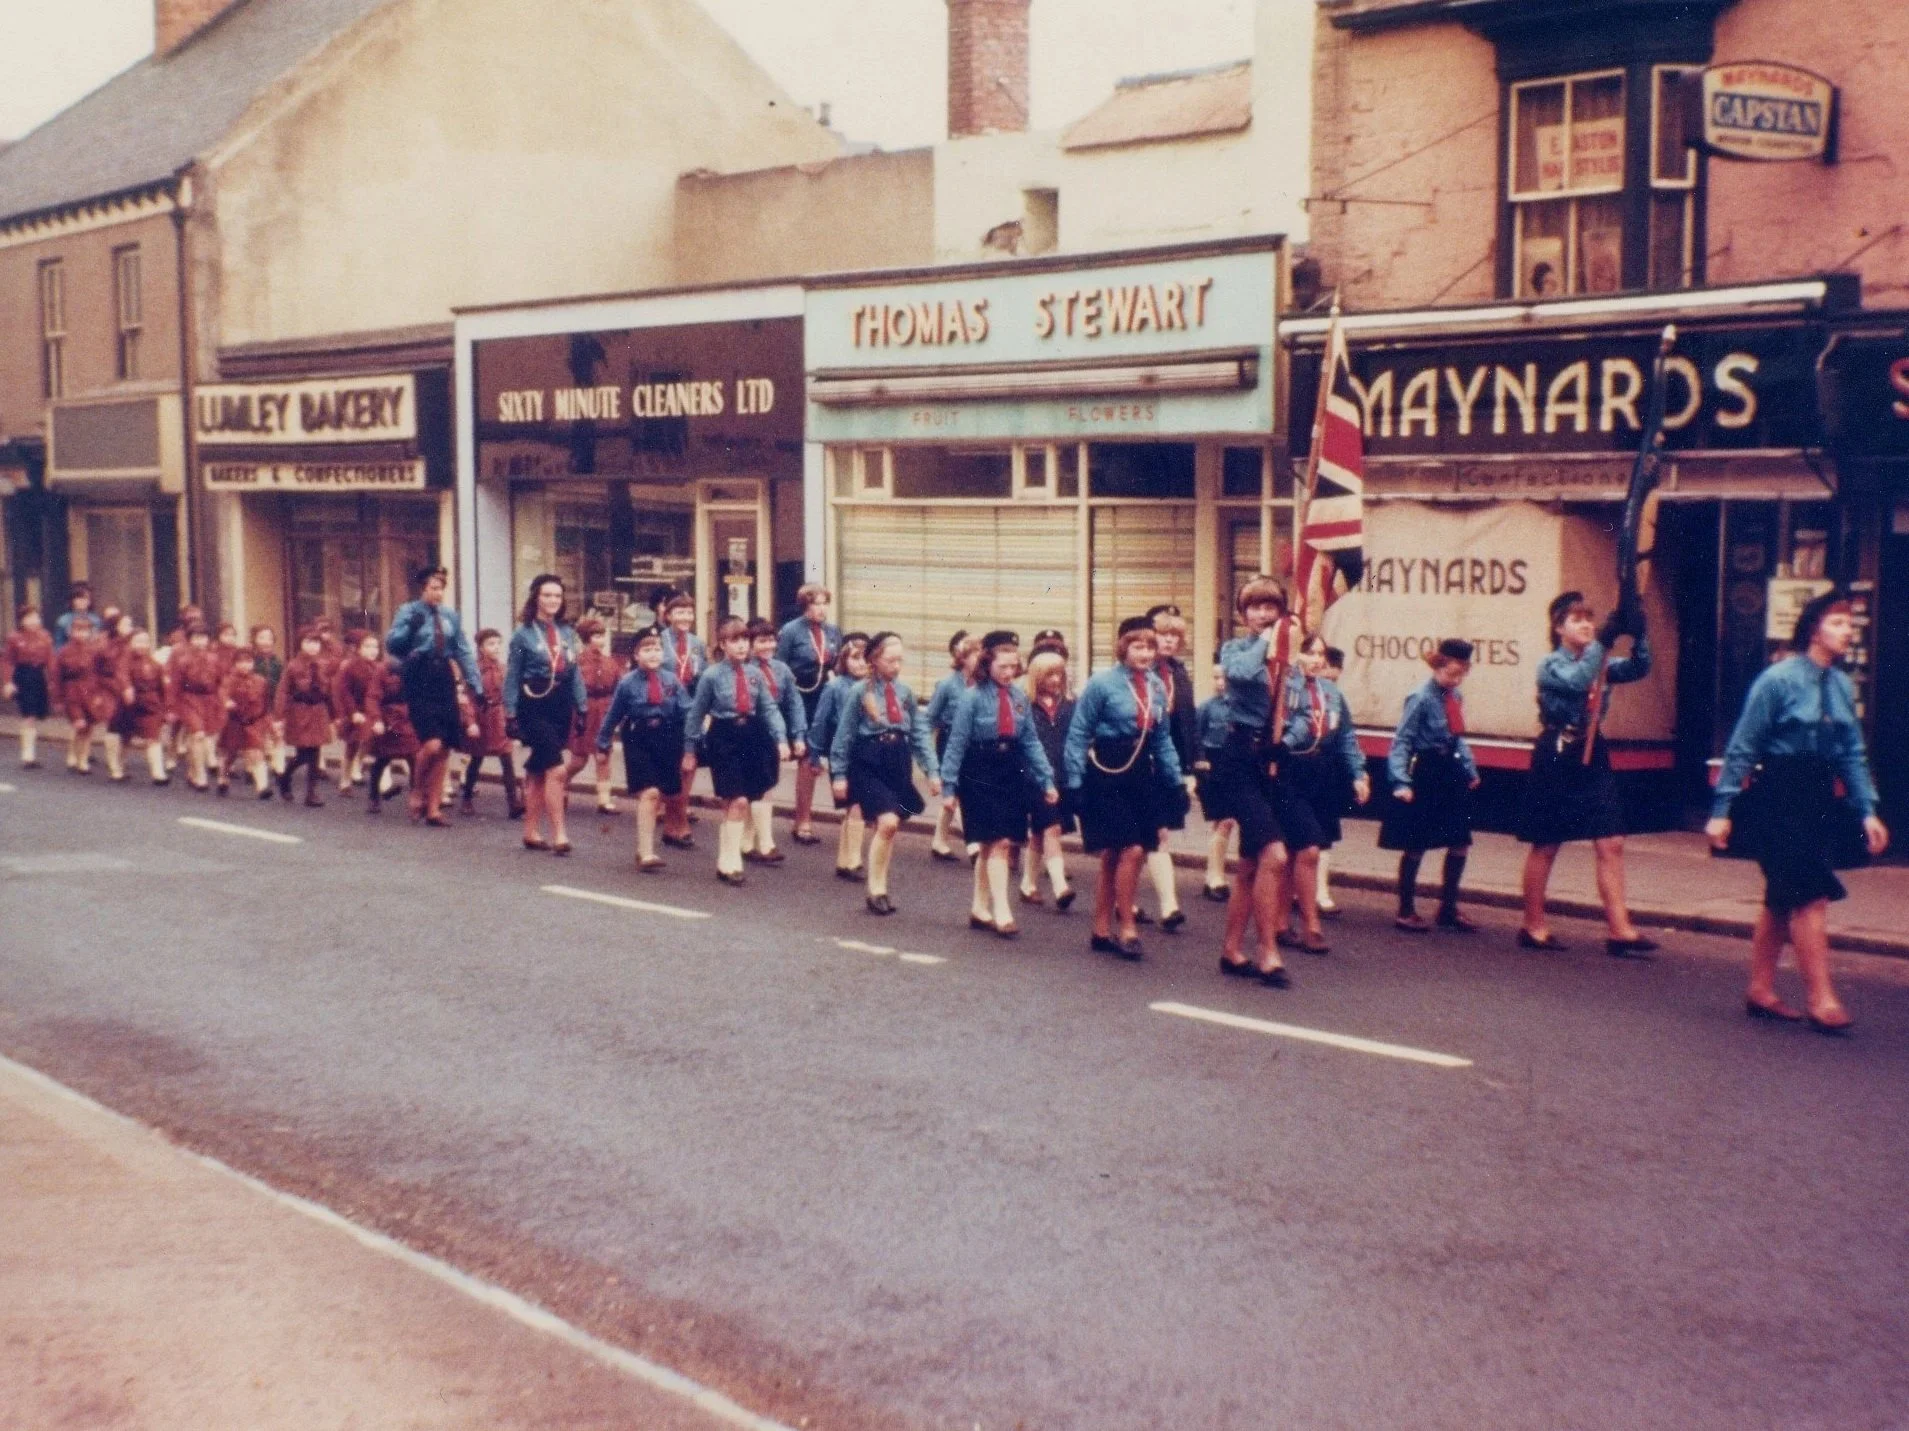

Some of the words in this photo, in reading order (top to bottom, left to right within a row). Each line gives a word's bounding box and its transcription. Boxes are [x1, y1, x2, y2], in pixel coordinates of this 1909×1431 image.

[1715, 95, 1819, 135] CAPSTAN
[850, 298, 990, 348] THOMAS
[1033, 276, 1214, 340] STEWART
[199, 392, 290, 434] LUMLEY
[299, 386, 405, 433] BAKERY
[498, 389, 545, 422] SIXTY
[554, 385, 621, 420] MINUTE
[632, 380, 724, 417] CLEANERS
[736, 378, 775, 414] LTD
[911, 410, 962, 426] FRUIT
[1067, 402, 1156, 423] FLOWERS
[1350, 351, 1760, 438] MAYNARDS
[1355, 634, 1521, 666] CHOCOTES
